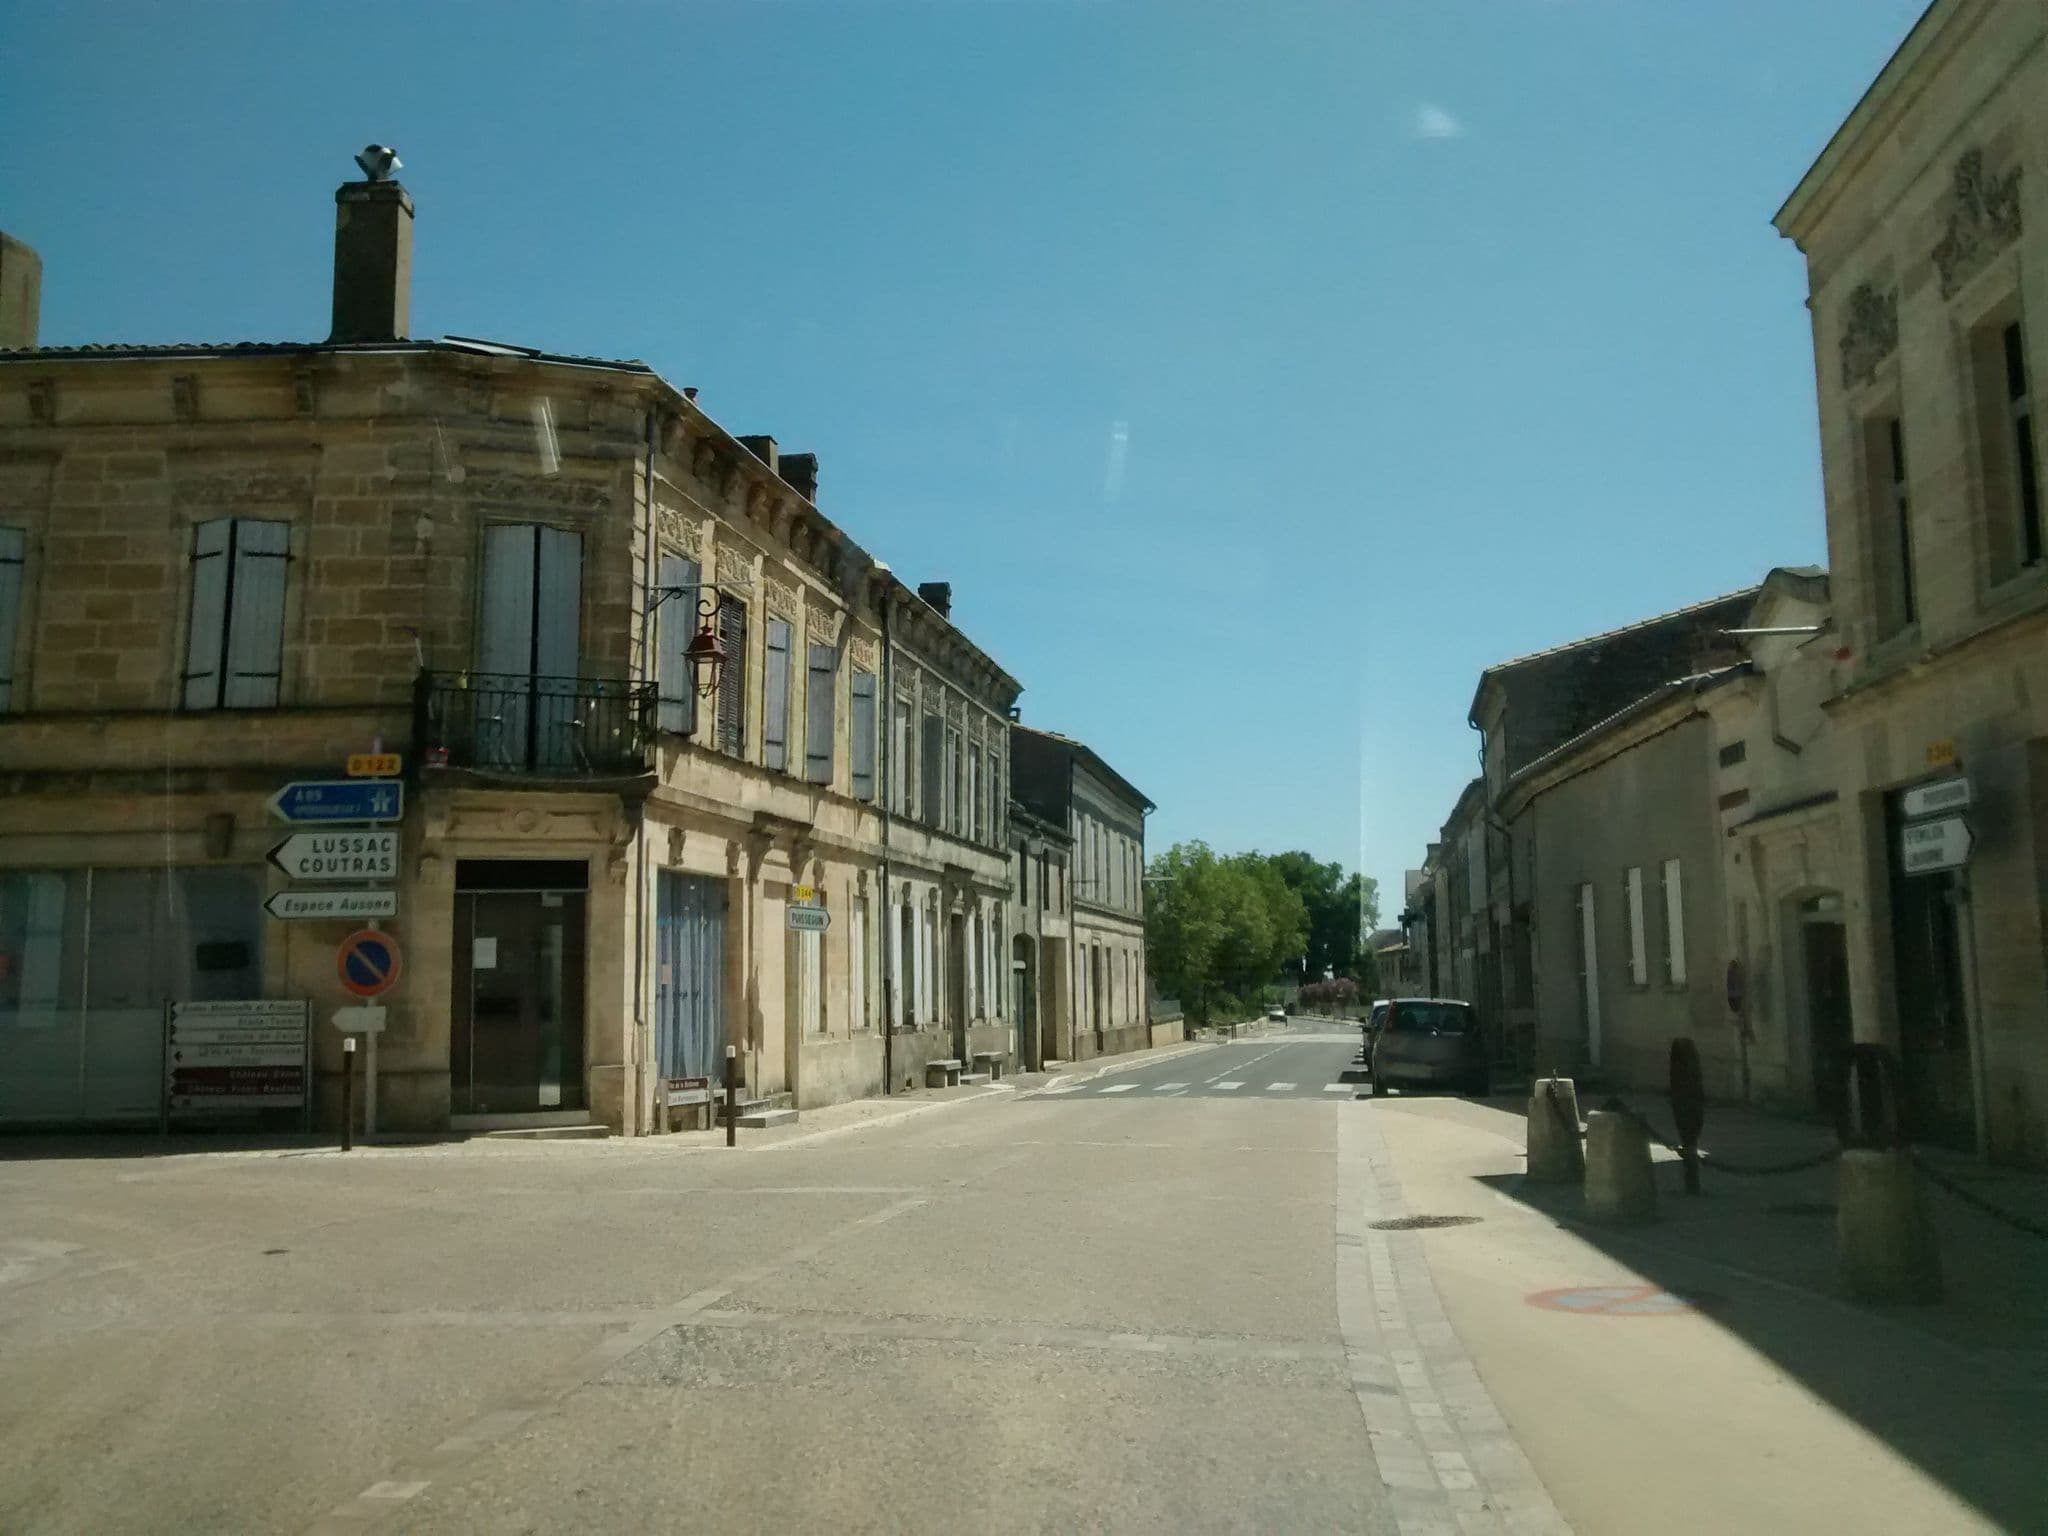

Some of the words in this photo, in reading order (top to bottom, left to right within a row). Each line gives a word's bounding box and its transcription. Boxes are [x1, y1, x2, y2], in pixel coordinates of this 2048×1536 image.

[312, 838, 391, 853] LUSSAC
[299, 857, 391, 873] COUTRAS
[285, 898, 333, 912] Espace
[791, 911, 824, 926] PUISSEGUIN
